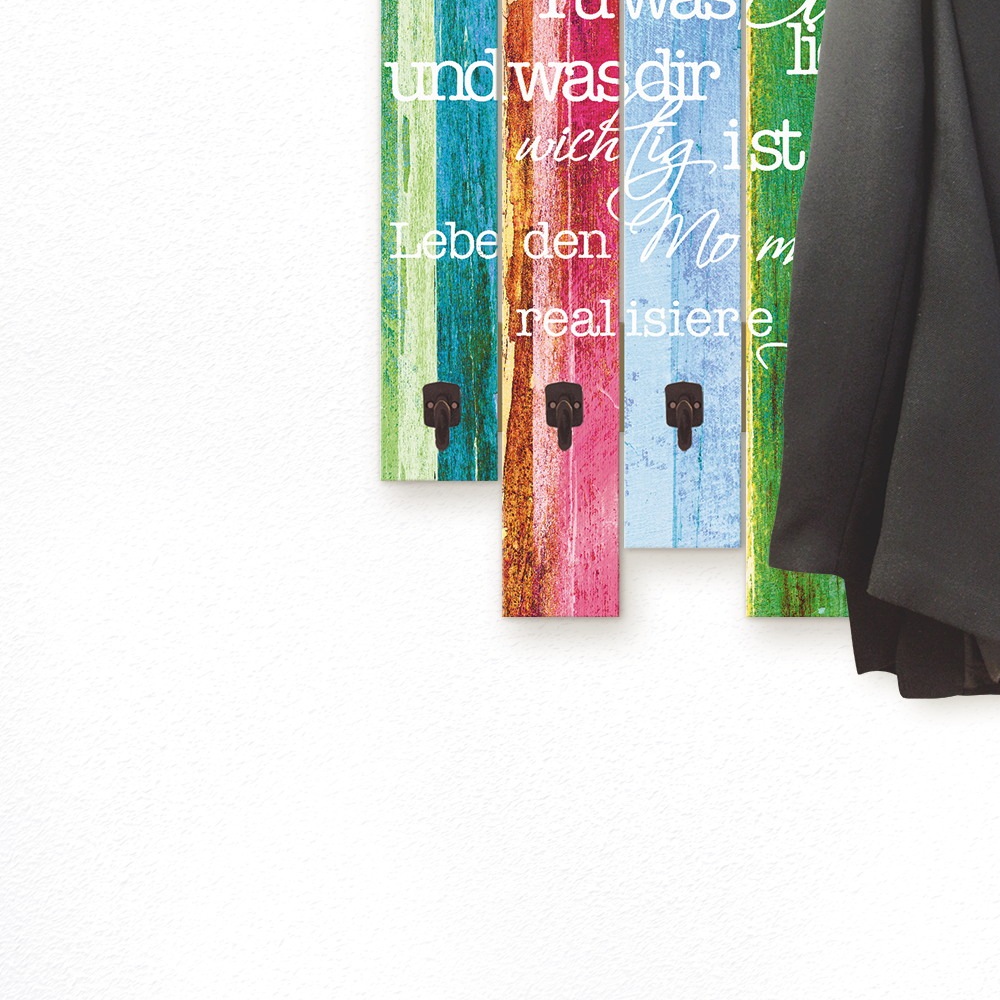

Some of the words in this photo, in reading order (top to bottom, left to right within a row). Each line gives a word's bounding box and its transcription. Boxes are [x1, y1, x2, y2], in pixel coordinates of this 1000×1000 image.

[385, 47, 498, 102] und
[504, 60, 630, 102] was
[634, 47, 721, 102] dir
[516, 80, 717, 200] wichtig
[723, 118, 806, 172] ist
[389, 222, 499, 261] Lebe
[523, 222, 612, 260] den
